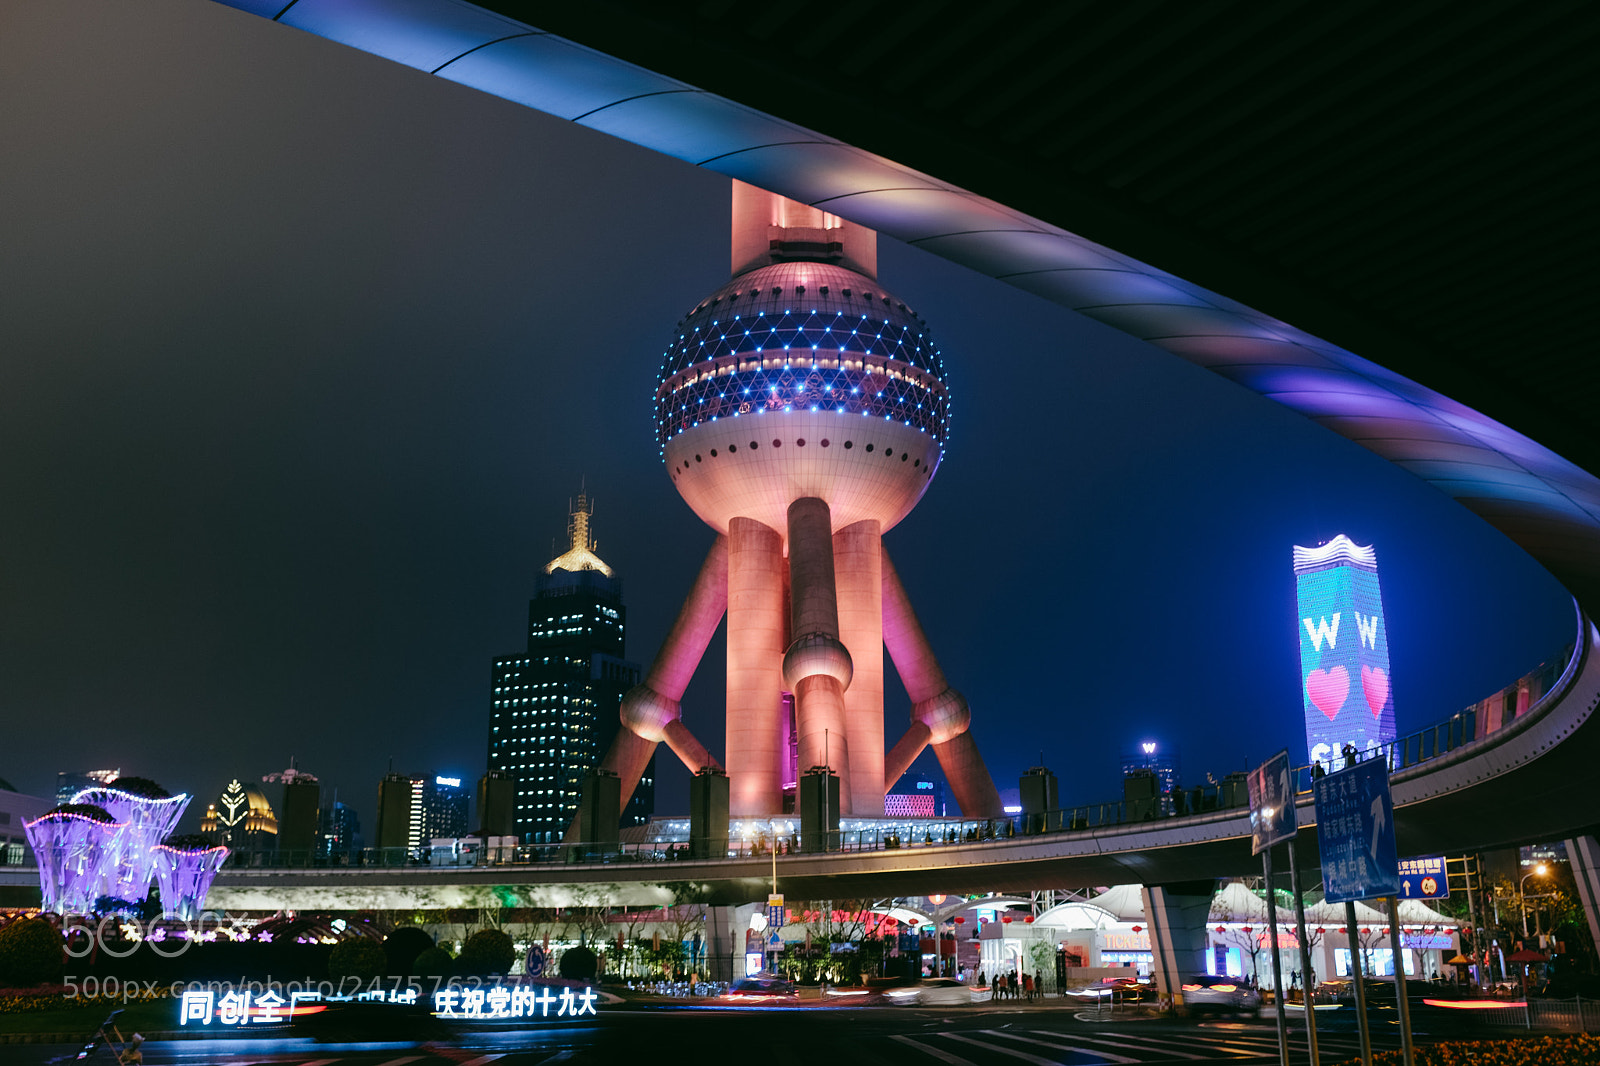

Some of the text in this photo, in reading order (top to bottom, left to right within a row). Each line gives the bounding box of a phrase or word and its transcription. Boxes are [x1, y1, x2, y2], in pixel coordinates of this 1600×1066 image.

[1303, 612, 1341, 652] W
[1354, 611, 1378, 650] W
[434, 985, 598, 1019] 庆祝党的十九大
